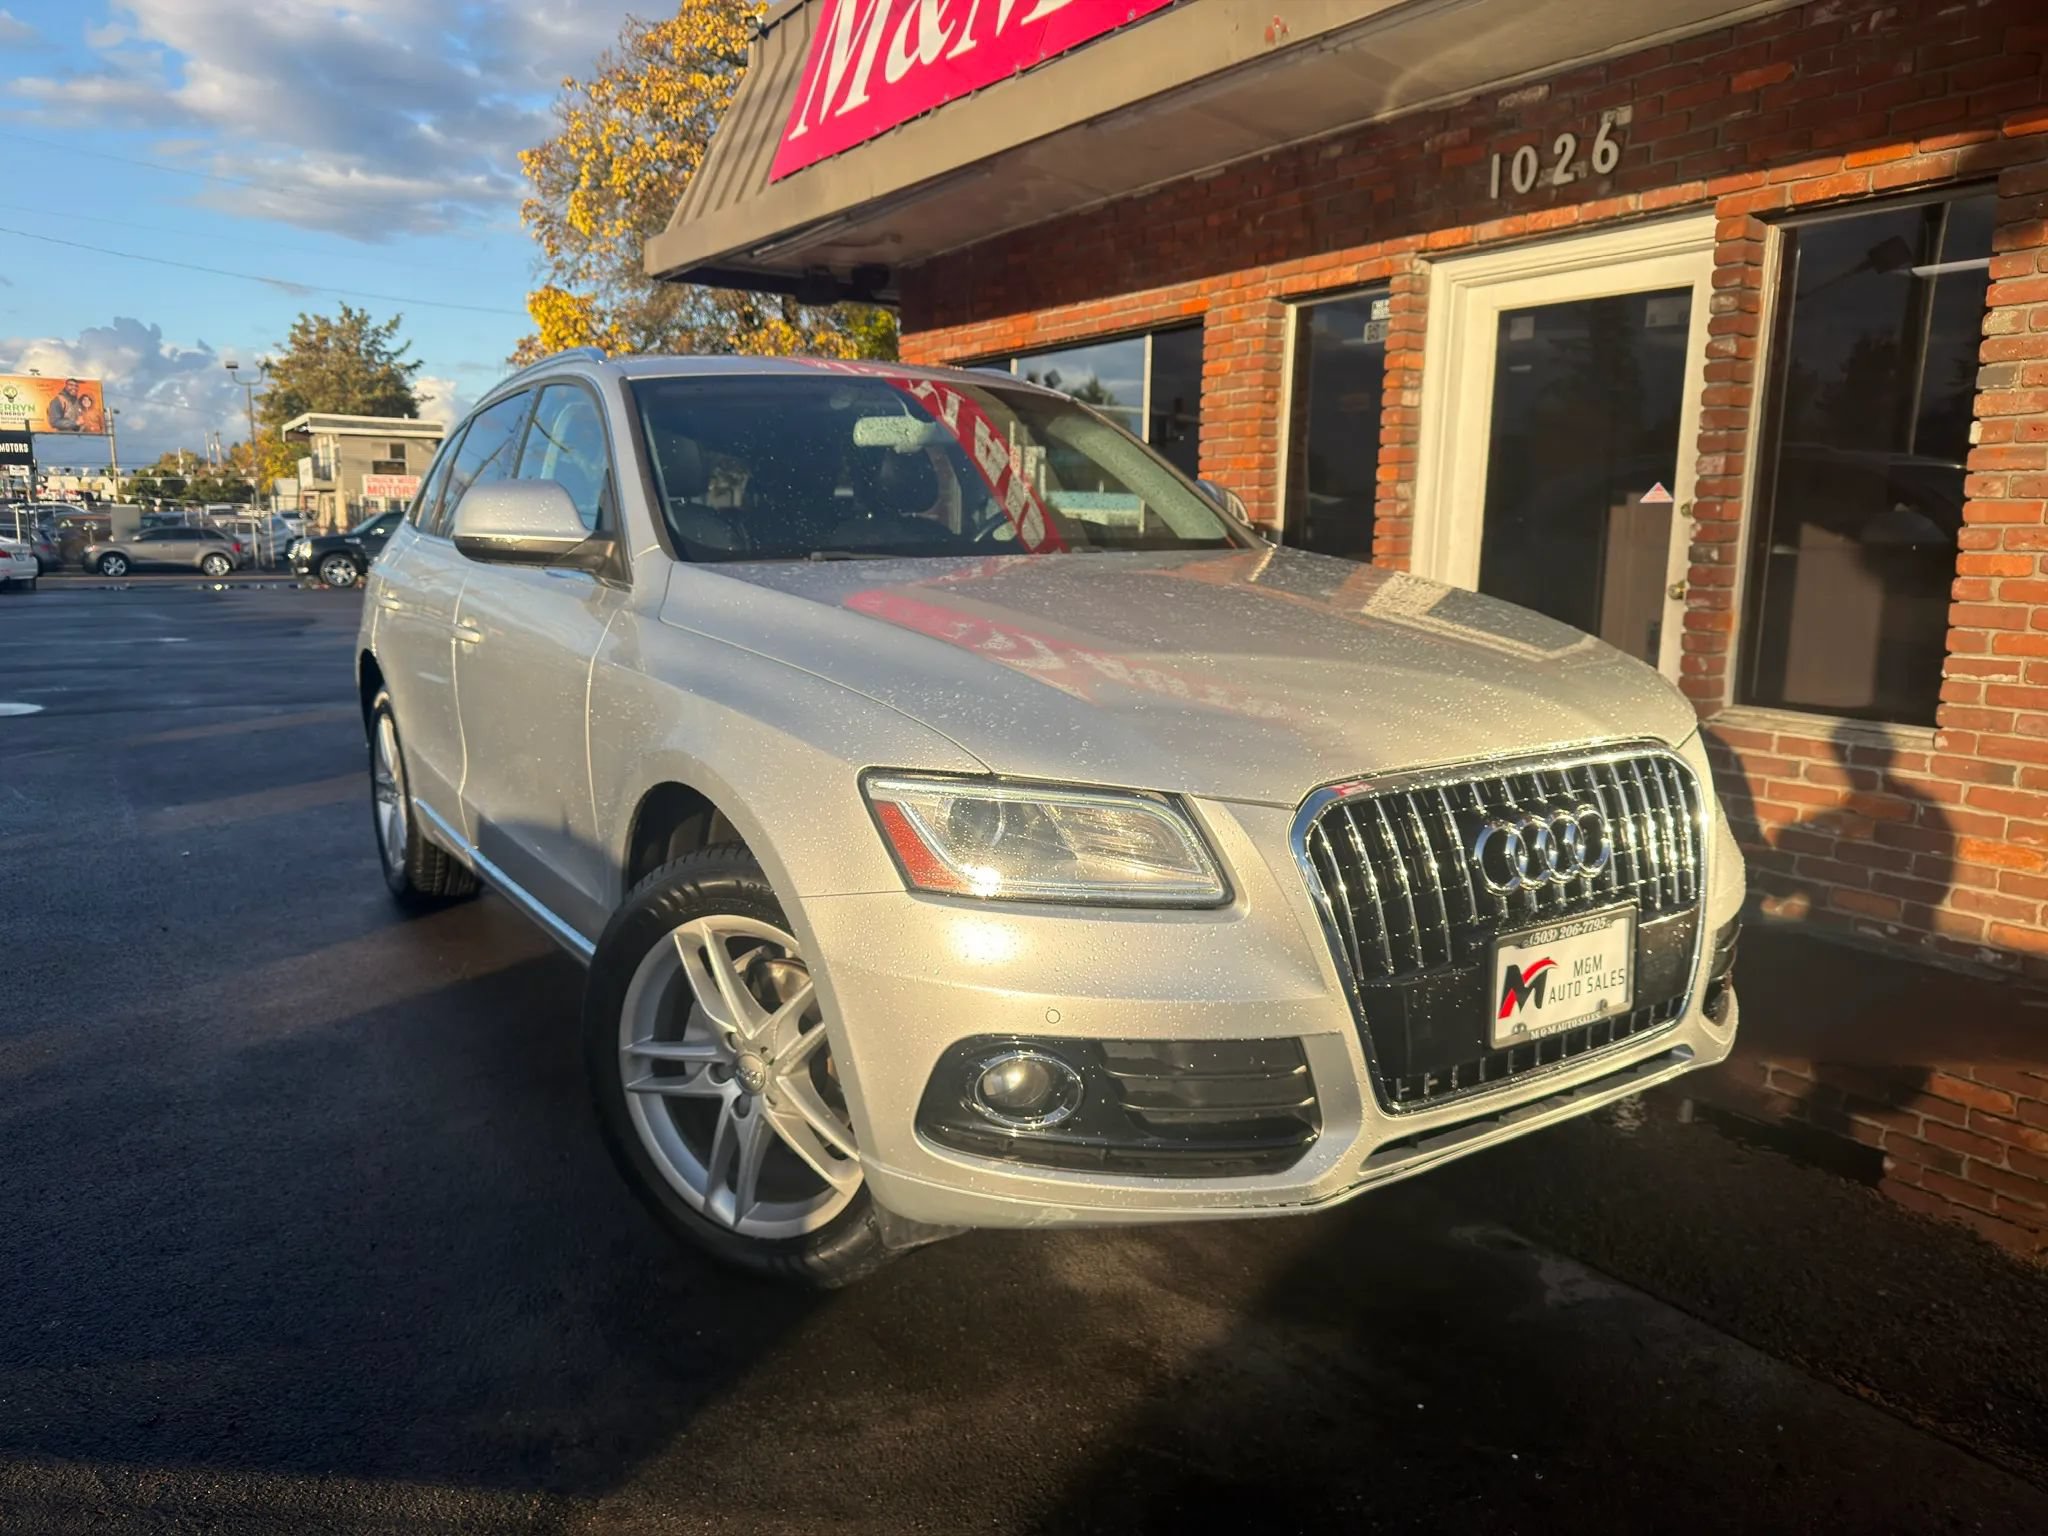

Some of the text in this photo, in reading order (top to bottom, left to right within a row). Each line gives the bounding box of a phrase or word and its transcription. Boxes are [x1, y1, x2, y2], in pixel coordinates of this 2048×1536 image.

[788, 0, 1073, 141] M&
[1490, 121, 1620, 200] 1026
[0, 442, 29, 454] MOTORS
[367, 485, 417, 498] MOTORS
[1529, 928, 1558, 946] (503)
[1547, 968, 1625, 1005] AUTO SALES
[1557, 1017, 1578, 1034] AUTO
